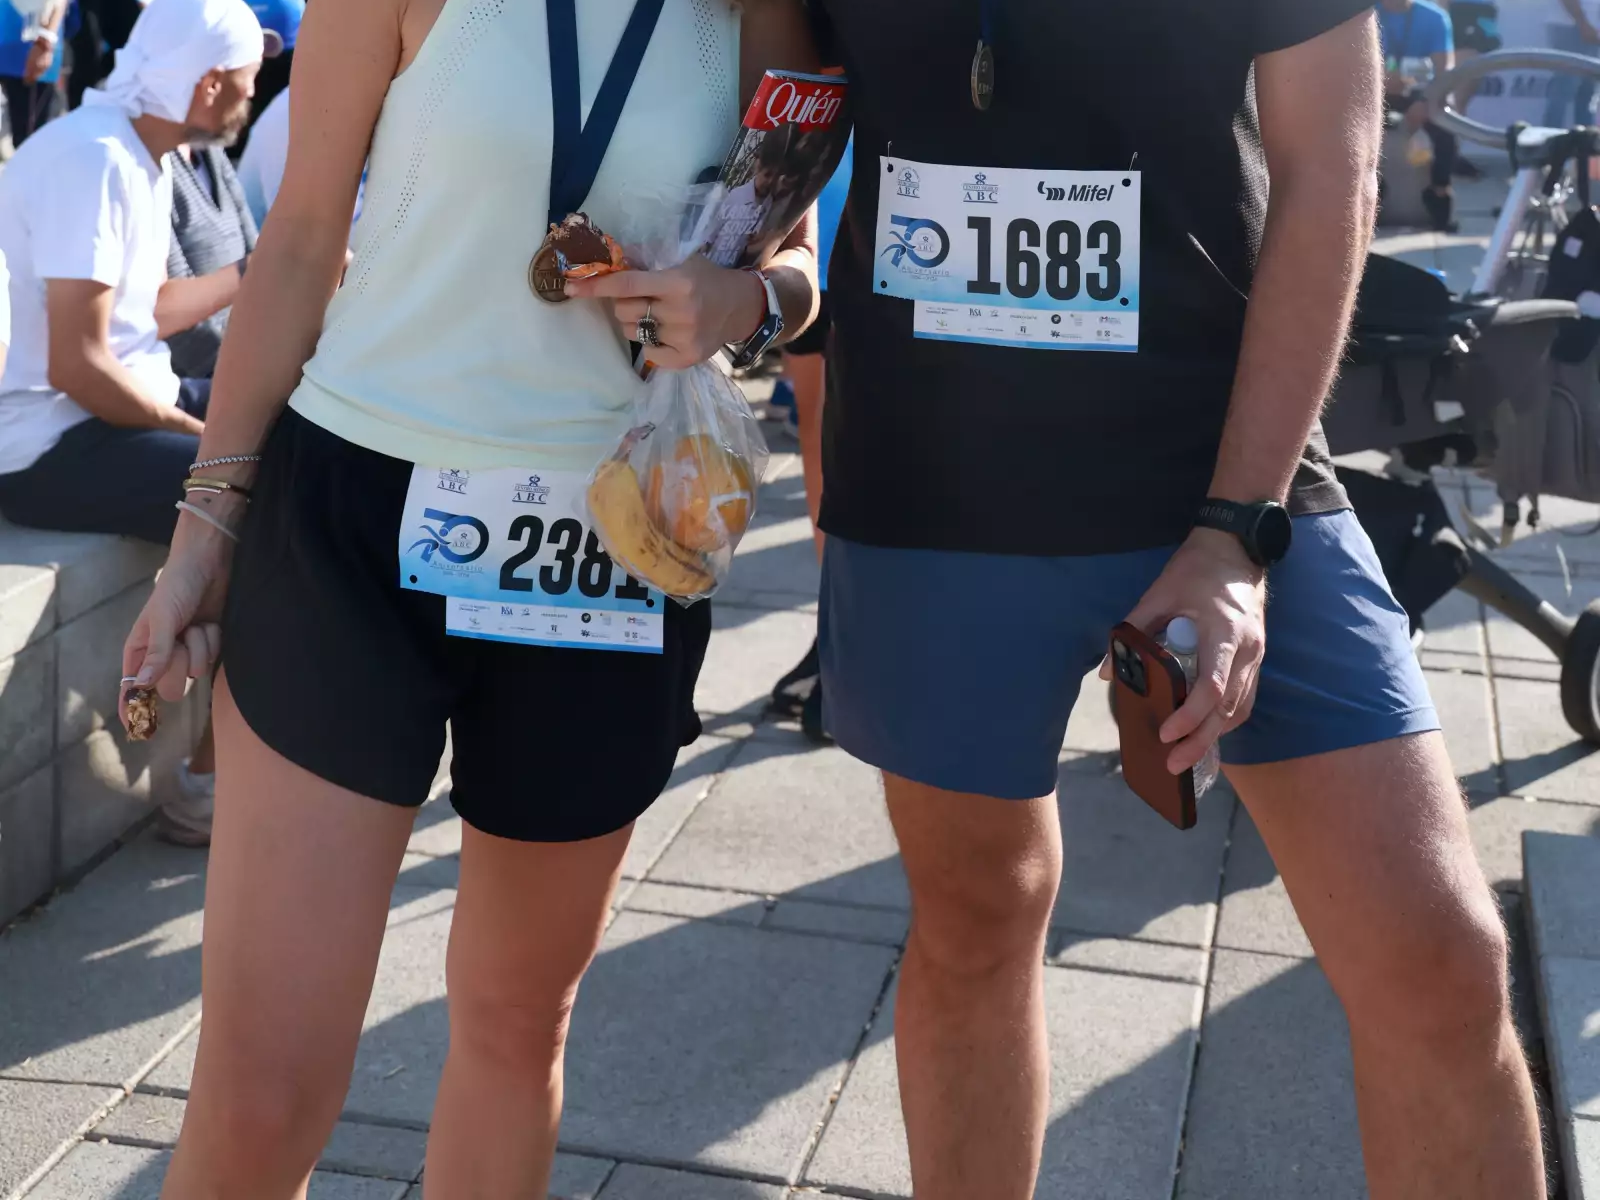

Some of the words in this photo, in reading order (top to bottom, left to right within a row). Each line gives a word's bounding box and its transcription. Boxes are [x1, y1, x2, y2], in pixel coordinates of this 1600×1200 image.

[764, 82, 841, 127] Quién
[1068, 184, 1114, 202] Mifel
[719, 220, 762, 235] SOUZA
[967, 215, 1121, 302] 1683
